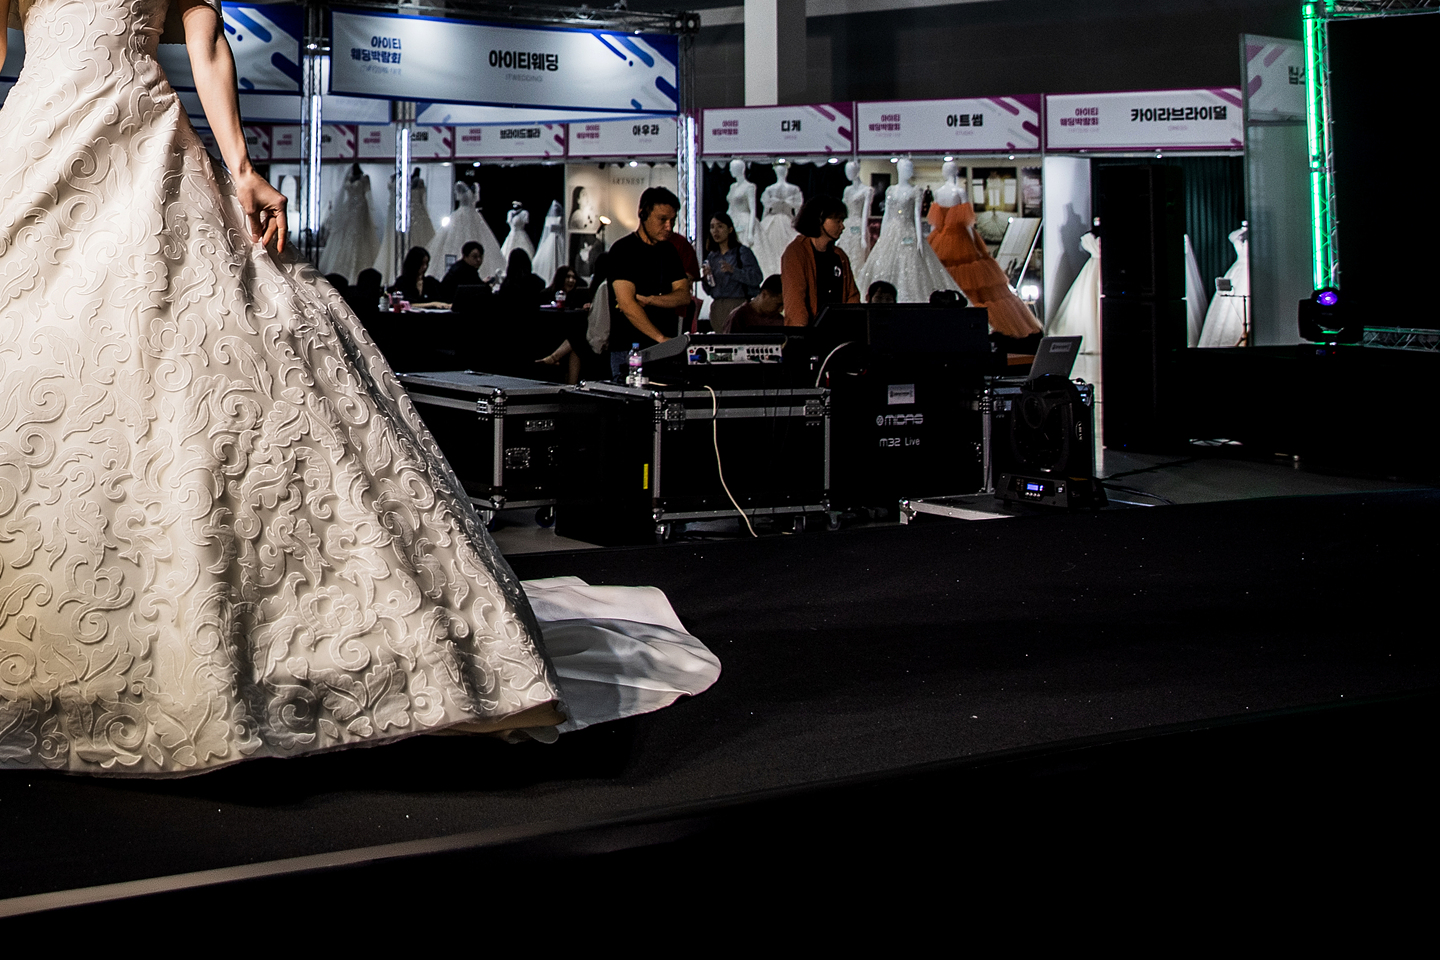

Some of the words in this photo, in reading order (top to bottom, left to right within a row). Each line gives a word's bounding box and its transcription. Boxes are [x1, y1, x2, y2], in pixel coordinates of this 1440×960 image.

[371, 36, 402, 50] 아이티
[351, 48, 401, 64] 웨딩박람회
[489, 50, 559, 71] 아이티웨딩
[631, 124, 660, 137] 아우라
[782, 120, 801, 132] 디케
[904, 436, 921, 447] Live
